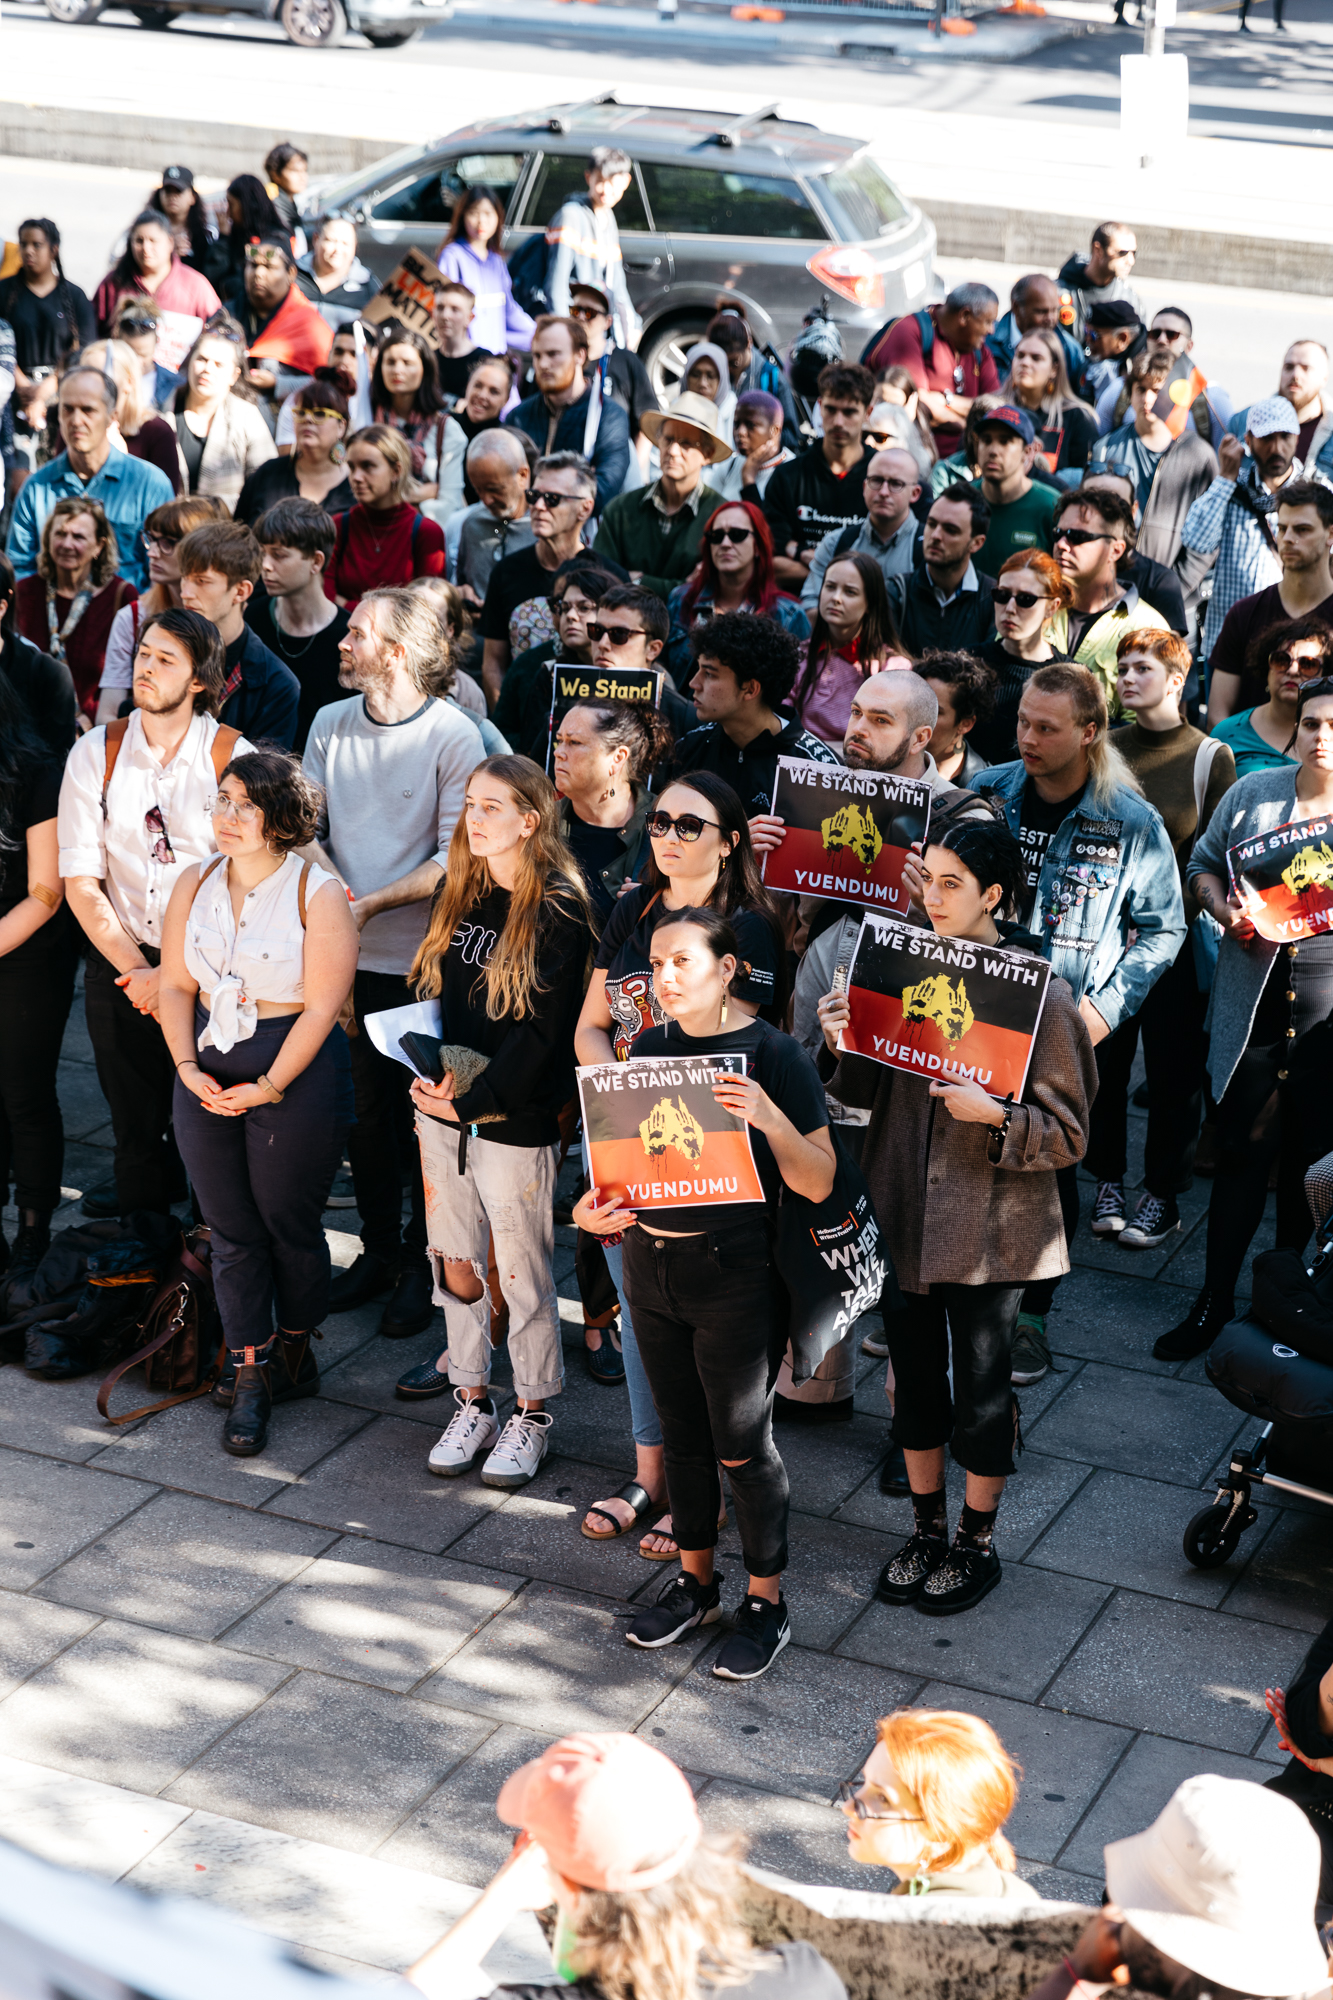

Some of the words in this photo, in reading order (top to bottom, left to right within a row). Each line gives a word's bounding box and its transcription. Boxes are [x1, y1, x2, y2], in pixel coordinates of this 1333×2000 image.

[560, 677, 590, 697] We
[595, 679, 653, 700] Stand
[789, 768, 817, 787] WE
[821, 776, 878, 797] STAND
[883, 784, 924, 807] WITH
[1237, 841, 1266, 861] WE
[1269, 822, 1328, 849] STAND
[794, 869, 899, 903] YUENDUMU
[874, 929, 906, 951] WE
[908, 939, 977, 970] STAND
[983, 957, 1039, 987] WITH
[872, 1035, 993, 1085] YUENDUMU
[592, 1075, 624, 1093] WE
[627, 1070, 684, 1090] STAND
[626, 1177, 738, 1200] YUENDUMU
[816, 1225, 843, 1235] Melbourne
[820, 1215, 880, 1271] WHEN
[844, 1246, 880, 1287] WE
